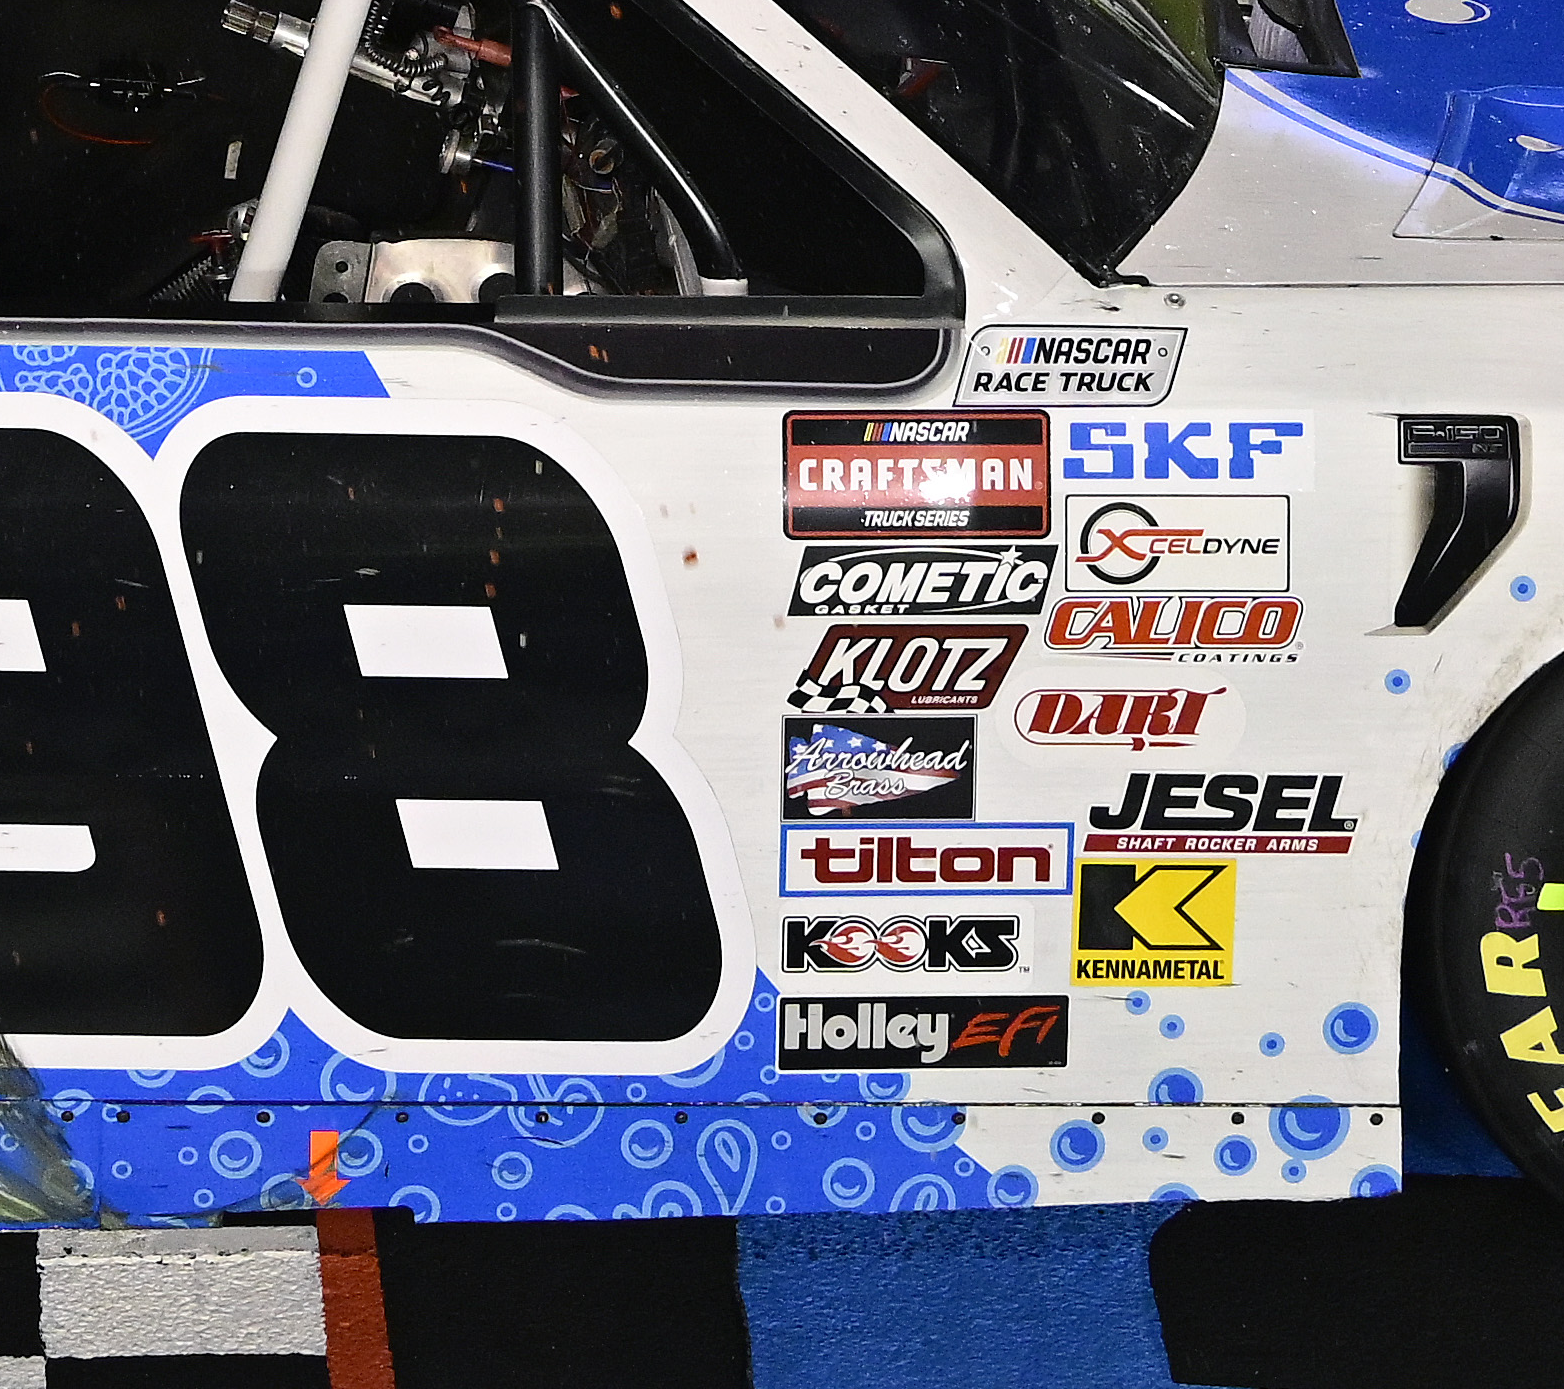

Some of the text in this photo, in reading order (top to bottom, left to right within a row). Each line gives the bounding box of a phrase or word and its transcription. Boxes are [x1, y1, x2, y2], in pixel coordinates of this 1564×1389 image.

[1034, 337, 1150, 365] NASCAR
[973, 371, 1155, 394] RACE TRUCK
[888, 422, 971, 443] NASCAR
[1063, 421, 1304, 481] SKF
[799, 457, 1033, 492] CRAFTSMAN
[864, 510, 971, 527] TRUCK SERIES
[800, 560, 1048, 604] COMETIC
[814, 604, 910, 615] GASKET
[1046, 598, 1301, 646] CALICO
[818, 637, 1009, 692] KLOTZ
[1177, 653, 1299, 663] COATINGS
[910, 694, 978, 704] LUBRICANTS
[1026, 687, 1228, 735] DART
[785, 737, 971, 774] Arrowhead
[825, 769, 907, 798] Brass
[1089, 773, 1359, 832] JESEL
[800, 837, 1050, 883] tilton
[1117, 837, 1319, 852] SHAFT ROCKER ARMS
[783, 915, 1021, 973] KOOKS
[1076, 959, 1225, 981] KENNAMETAL
[783, 1002, 1061, 1064] Holley EFI
